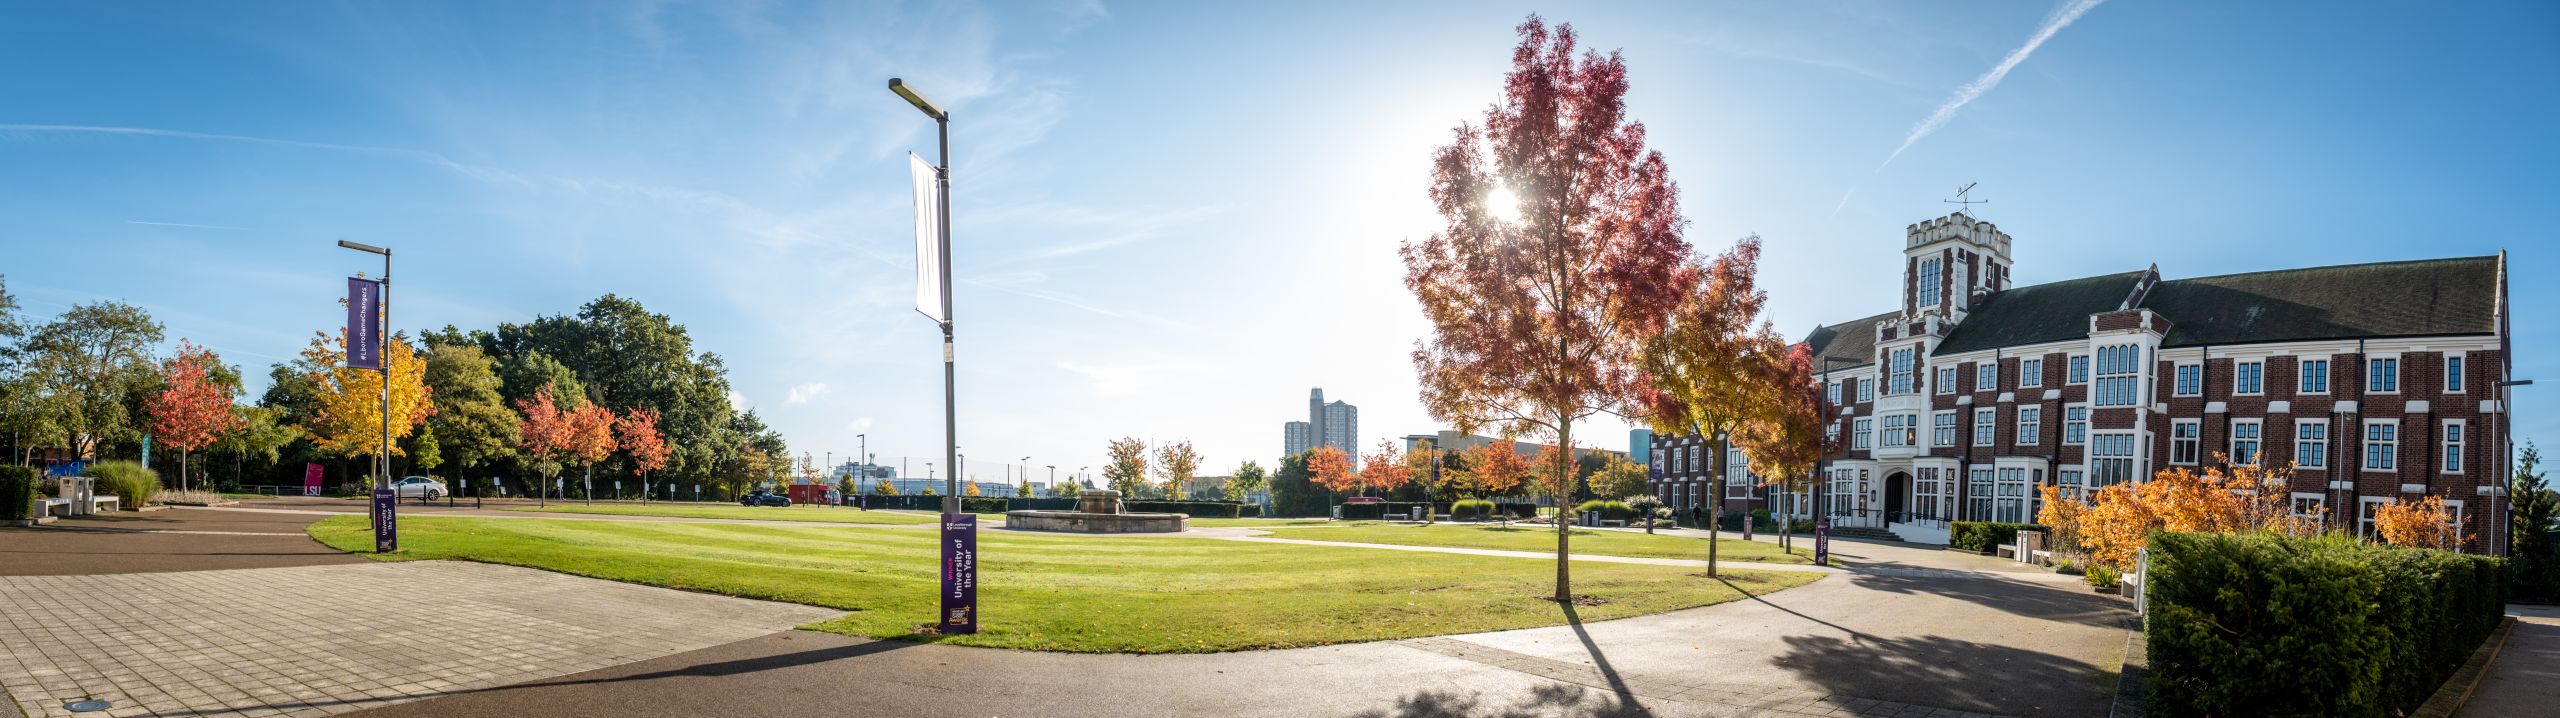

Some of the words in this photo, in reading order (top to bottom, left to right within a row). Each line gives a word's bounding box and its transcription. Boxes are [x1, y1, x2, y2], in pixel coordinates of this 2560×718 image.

[360, 287, 368, 360] #LboroGameChangers
[304, 486, 321, 496] LSU
[954, 539, 962, 548] of
[954, 550, 964, 598] University
